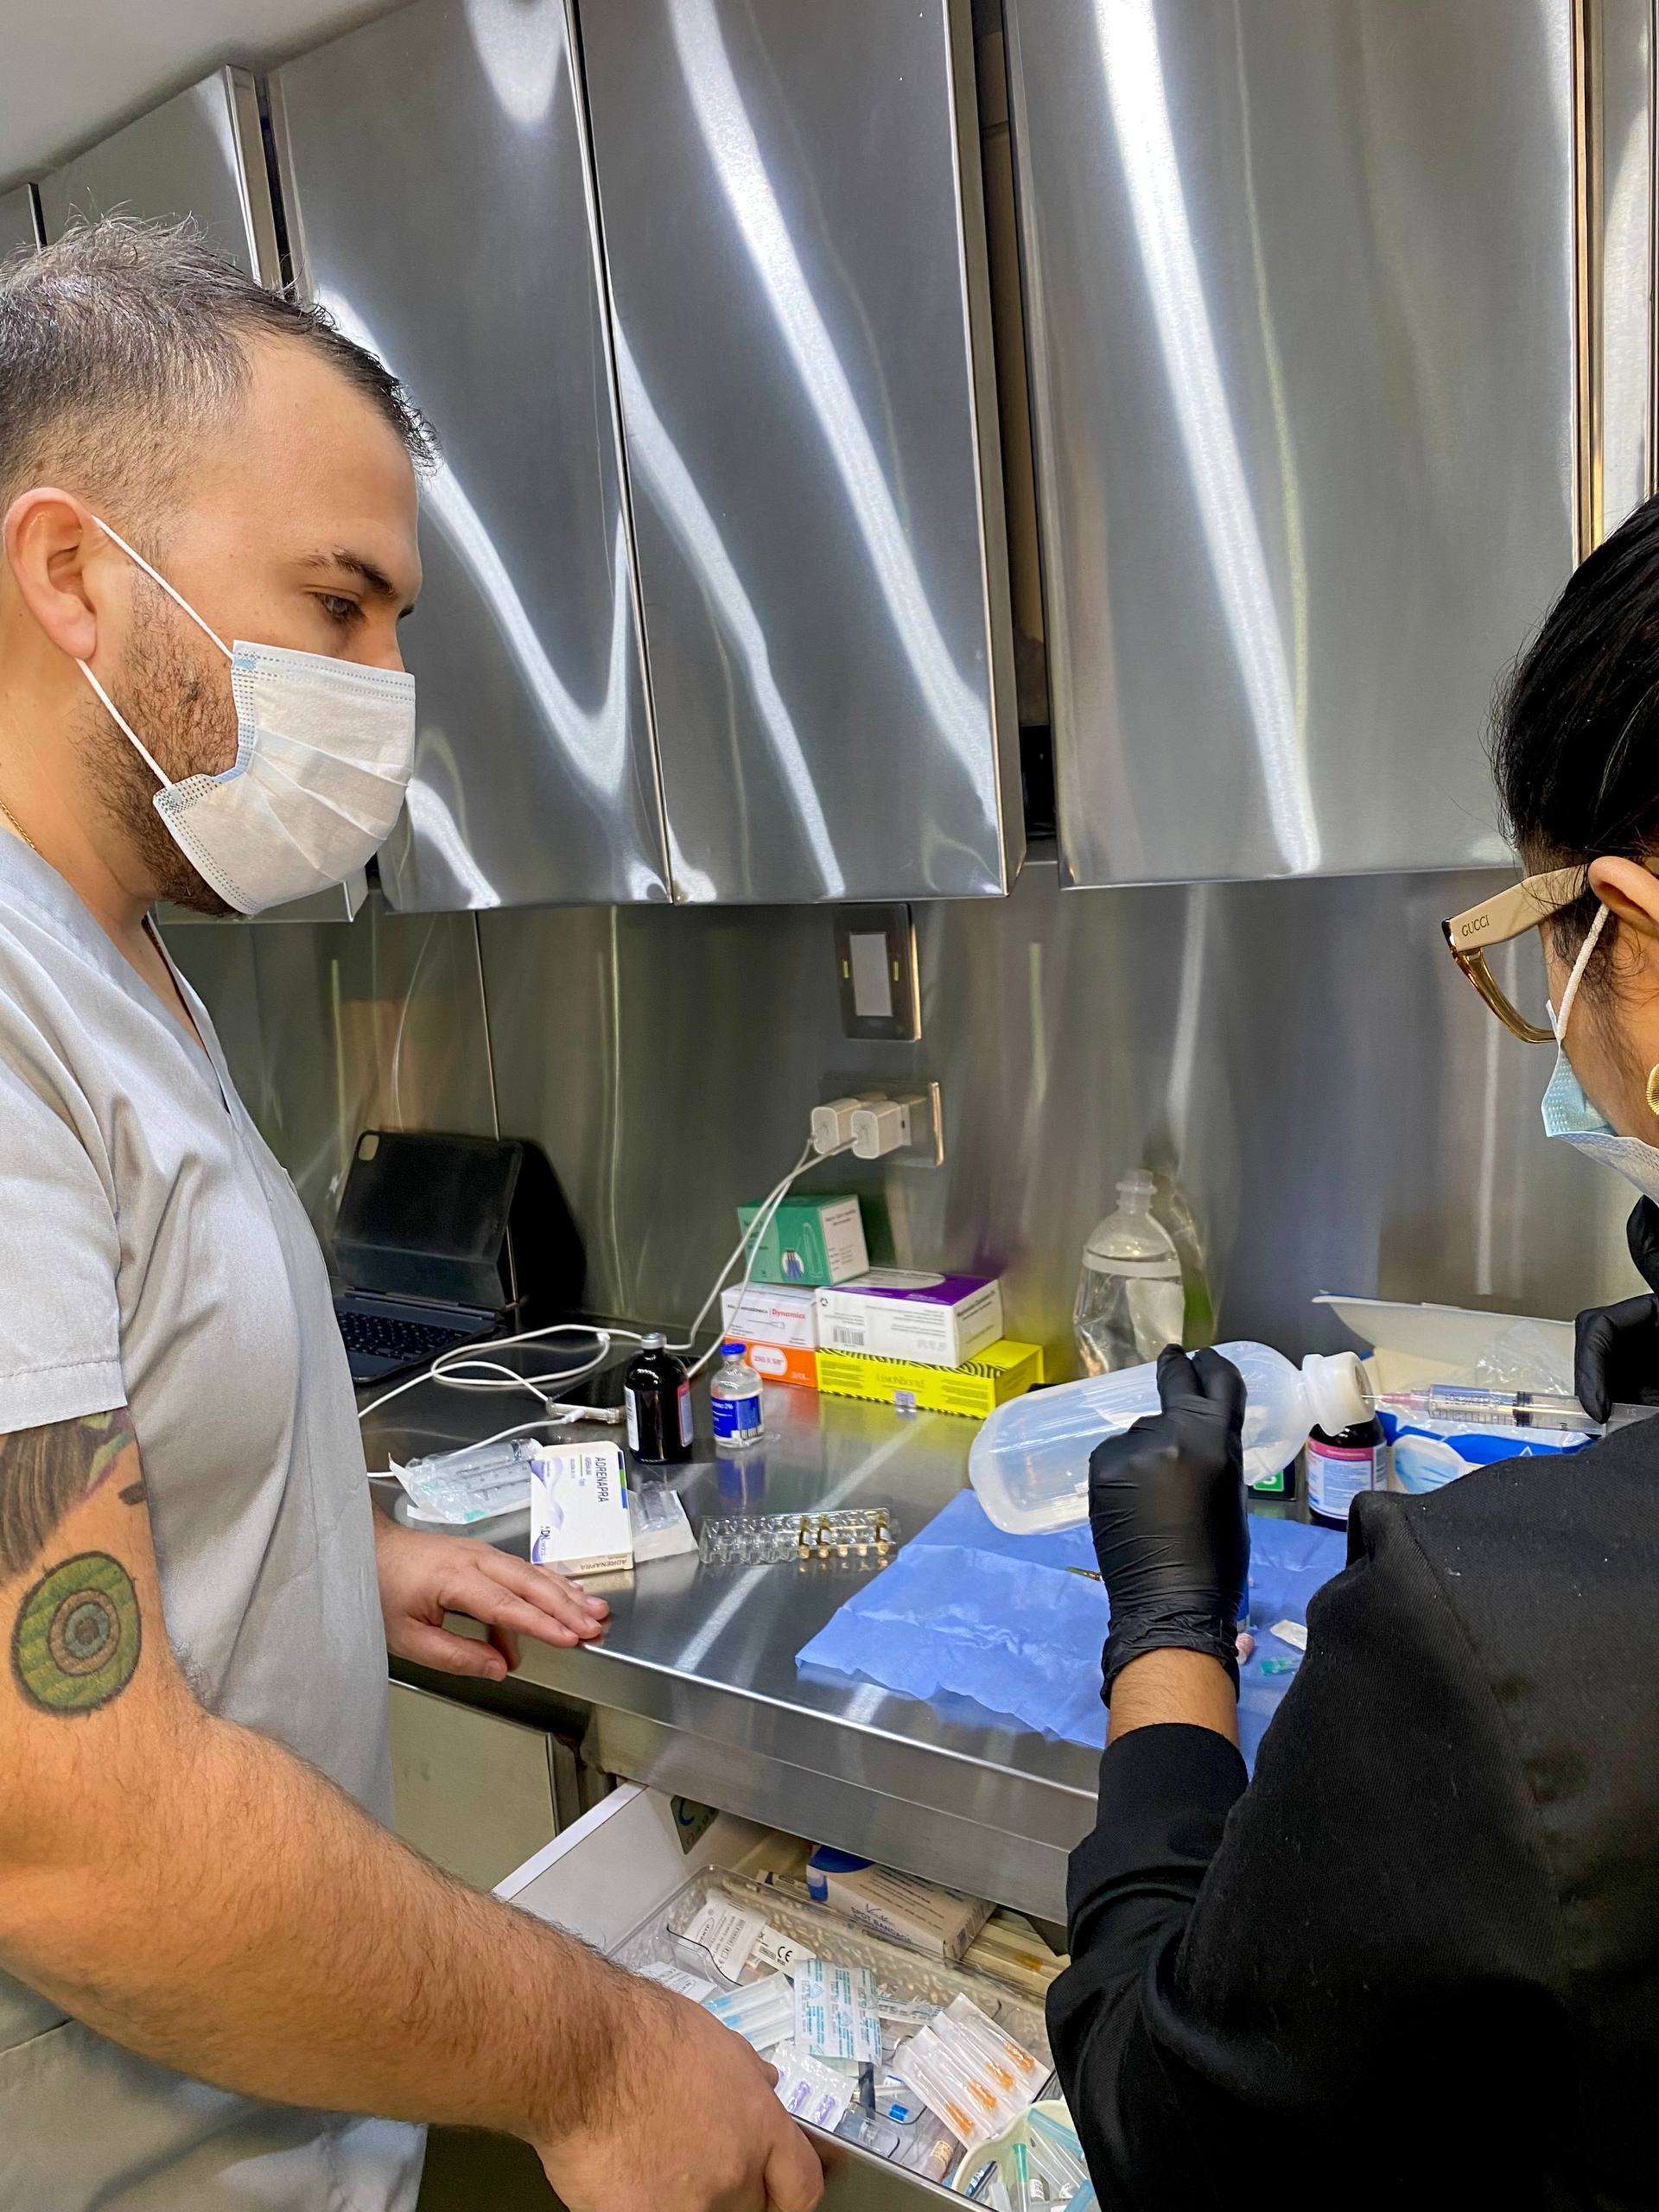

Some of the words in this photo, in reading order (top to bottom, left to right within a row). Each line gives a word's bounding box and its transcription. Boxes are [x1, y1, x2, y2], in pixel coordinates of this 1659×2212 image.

[1461, 914, 1490, 937] GUCCI
[772, 1307, 807, 1319] Dynamics
[594, 1456, 609, 1503] ADRENAPRA
[580, 1558, 628, 1571] ADRENAPRA
